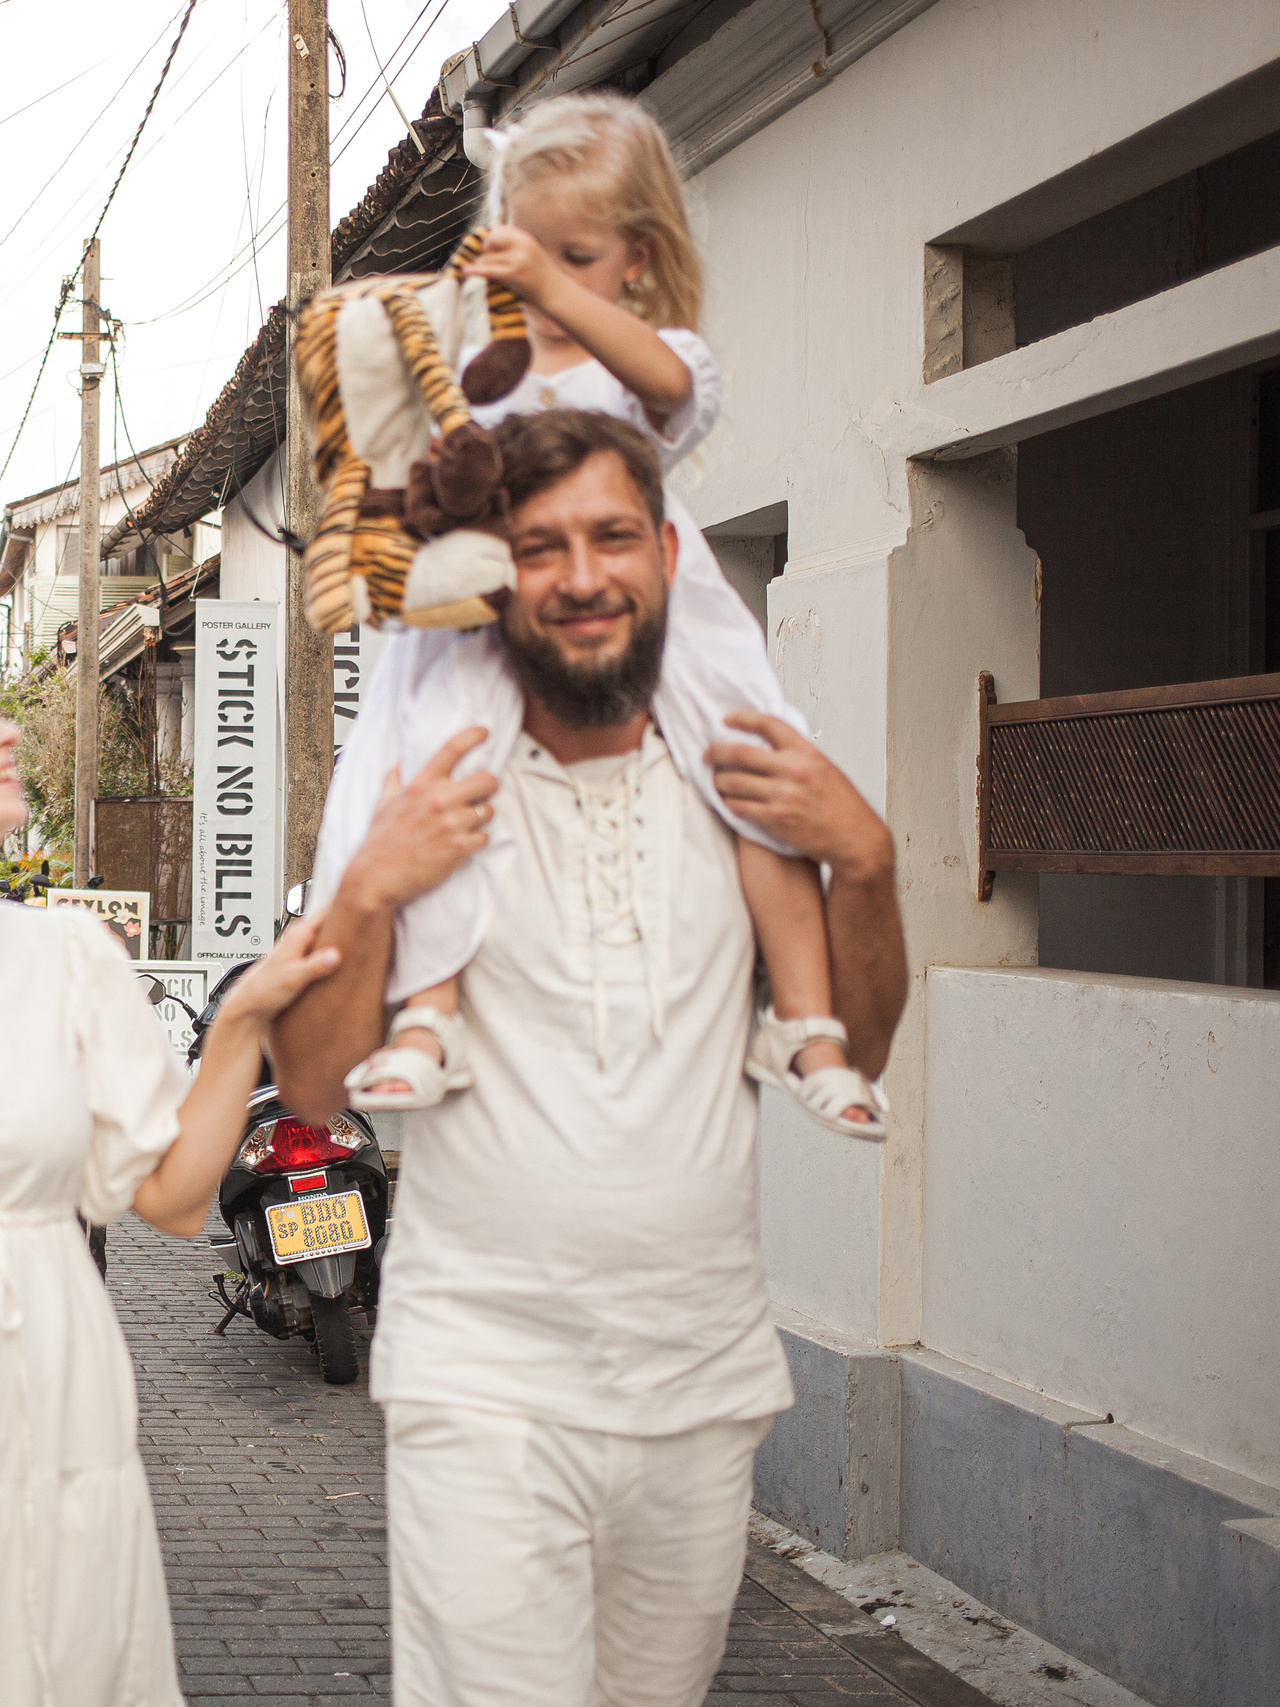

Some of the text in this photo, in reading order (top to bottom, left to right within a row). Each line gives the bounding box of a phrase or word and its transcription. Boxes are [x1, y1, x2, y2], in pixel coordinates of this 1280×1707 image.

[235, 622, 272, 630] GALLERY
[216, 765, 254, 816] NO
[198, 812, 208, 926] It's all about the image
[215, 833, 253, 937] BILLS
[297, 1192, 328, 1201] HONDA
[301, 1199, 347, 1225] BDO
[278, 1220, 354, 1247] SP 8080
